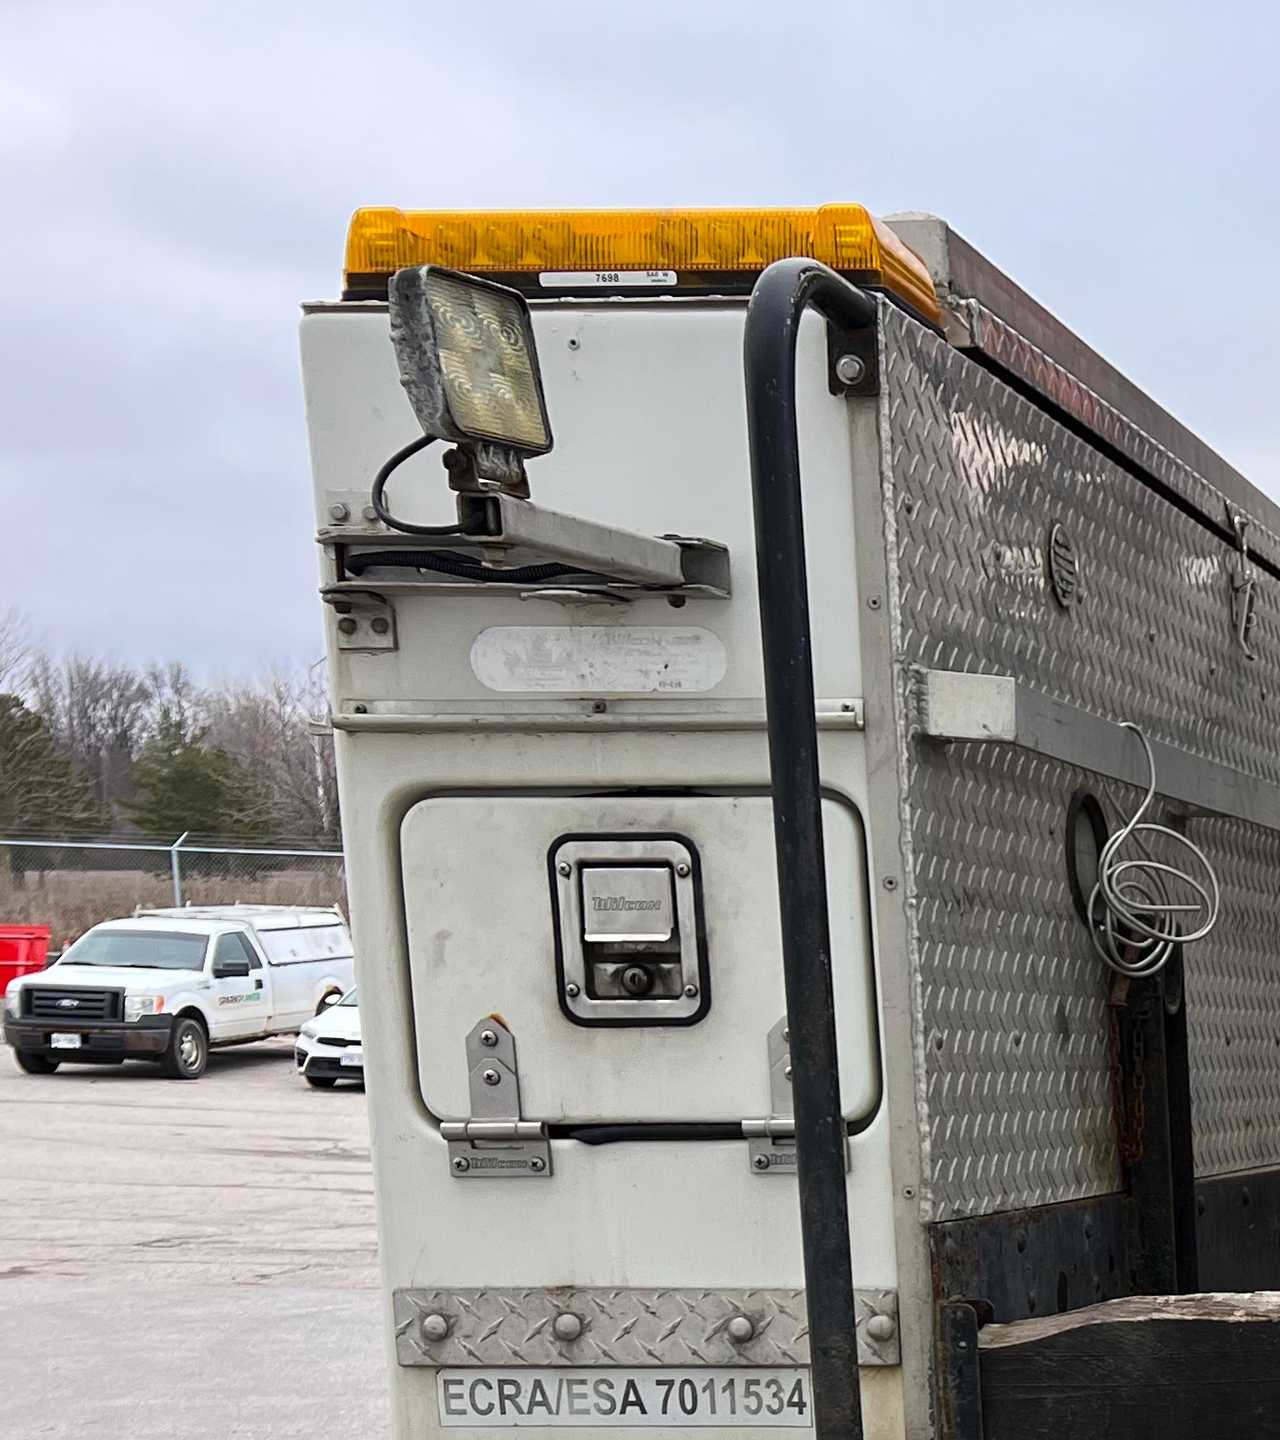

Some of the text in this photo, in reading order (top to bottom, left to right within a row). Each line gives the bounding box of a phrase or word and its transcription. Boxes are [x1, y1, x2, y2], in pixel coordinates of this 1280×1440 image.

[596, 274, 619, 282] 7698
[442, 1378, 808, 1417] ECRA/ESA 7011534
